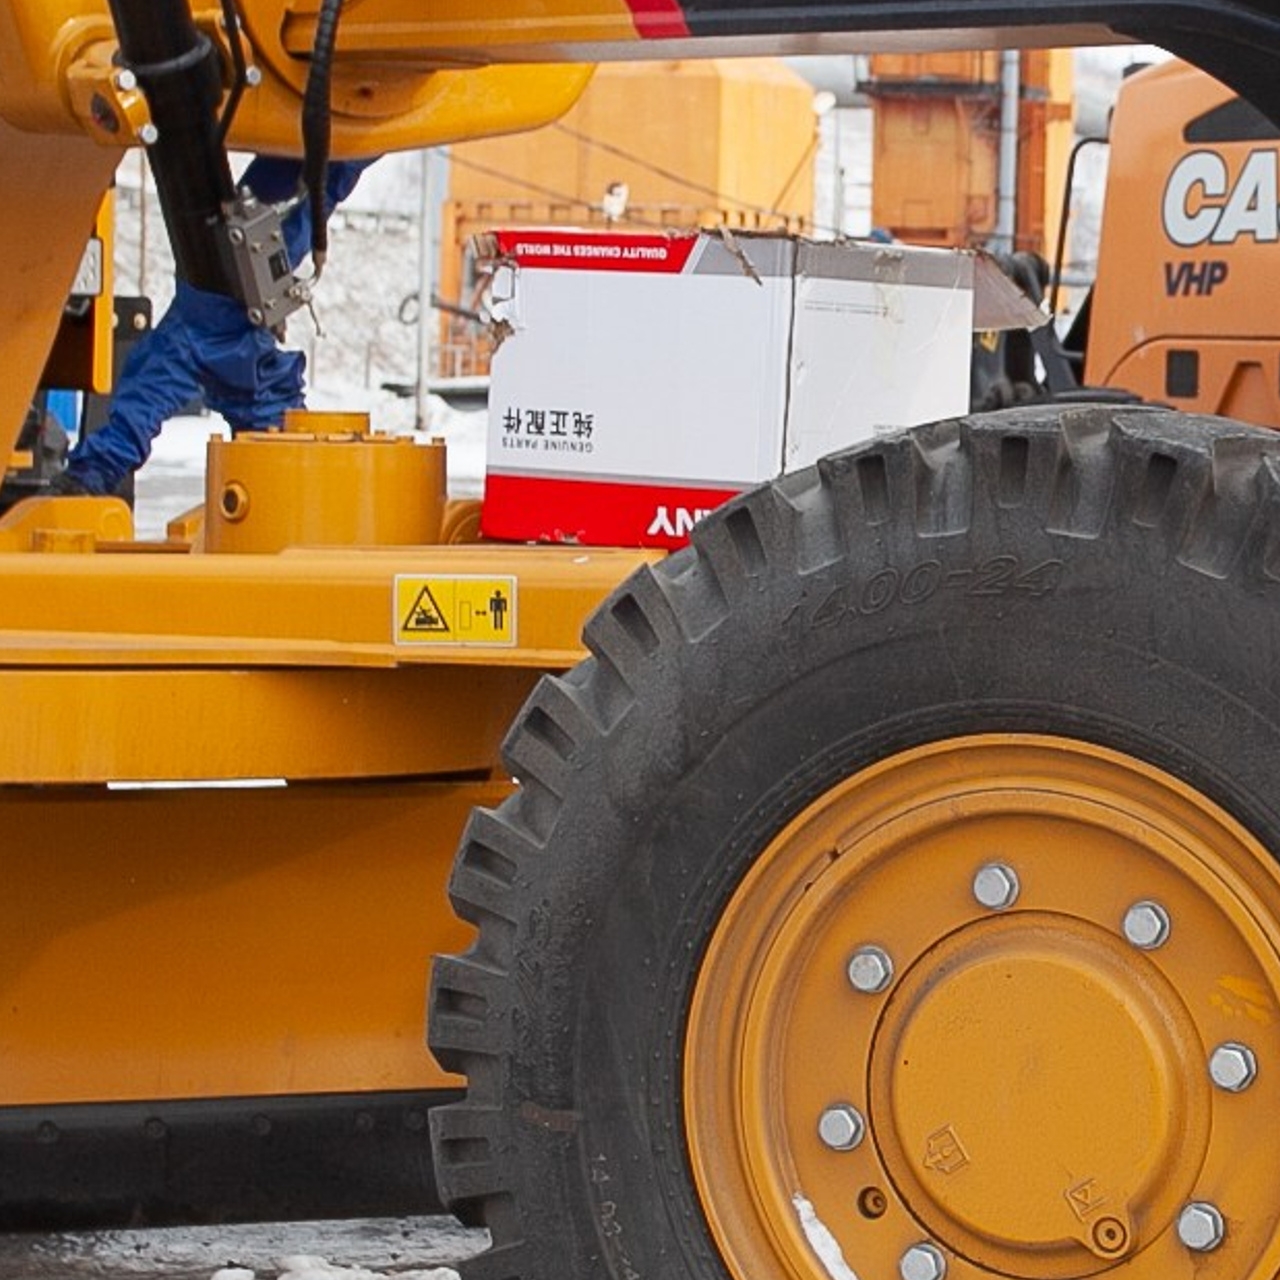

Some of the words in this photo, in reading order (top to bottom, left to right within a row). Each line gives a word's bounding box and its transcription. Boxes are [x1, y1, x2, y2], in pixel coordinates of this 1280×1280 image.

[516, 242, 551, 256] WORLD
[553, 243, 572, 257] THE
[573, 245, 621, 258] CHANGES
[621, 246, 668, 260] QUALITY
[1164, 260, 1229, 297] VHP
[502, 406, 595, 438] 纯正配件
[502, 436, 539, 450] PARTS
[543, 440, 594, 454] GENUINE
